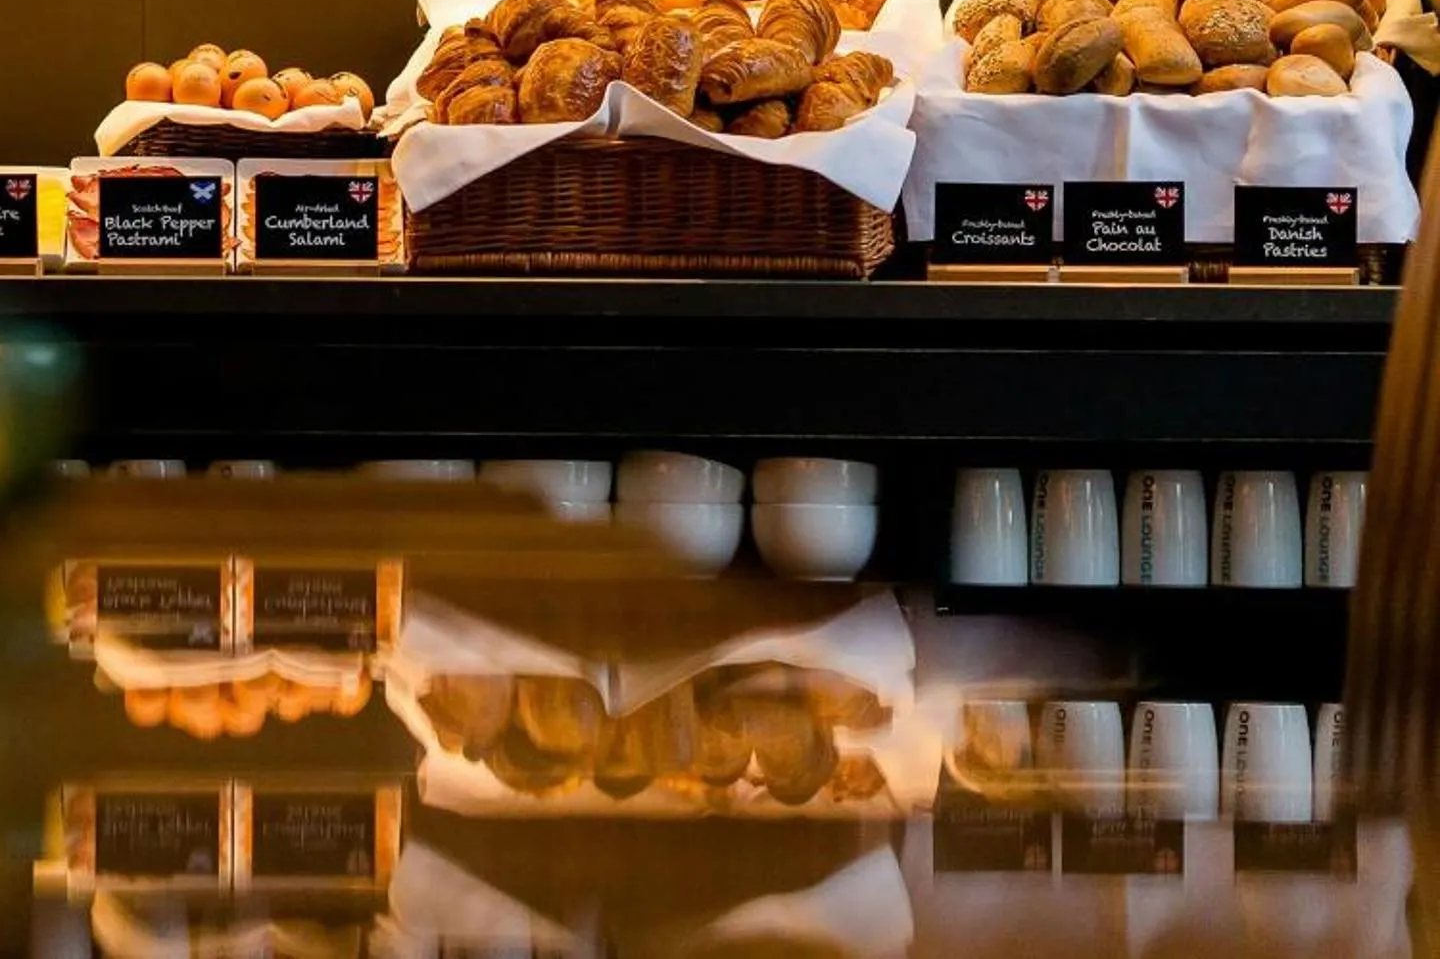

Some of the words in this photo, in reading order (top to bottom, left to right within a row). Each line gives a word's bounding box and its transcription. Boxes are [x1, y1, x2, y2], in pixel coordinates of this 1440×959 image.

[104, 214, 154, 231] Black
[160, 215, 217, 239] Pepper
[264, 213, 371, 231] Cumberland
[1091, 221, 1129, 236] Pain
[1135, 224, 1157, 236] au
[107, 231, 182, 248] Pastrami
[288, 231, 346, 247] Salami
[951, 230, 1037, 247] Croissants
[1268, 226, 1324, 241] Danish
[1085, 237, 1163, 253] Chocolat
[1262, 242, 1329, 258] Pastries
